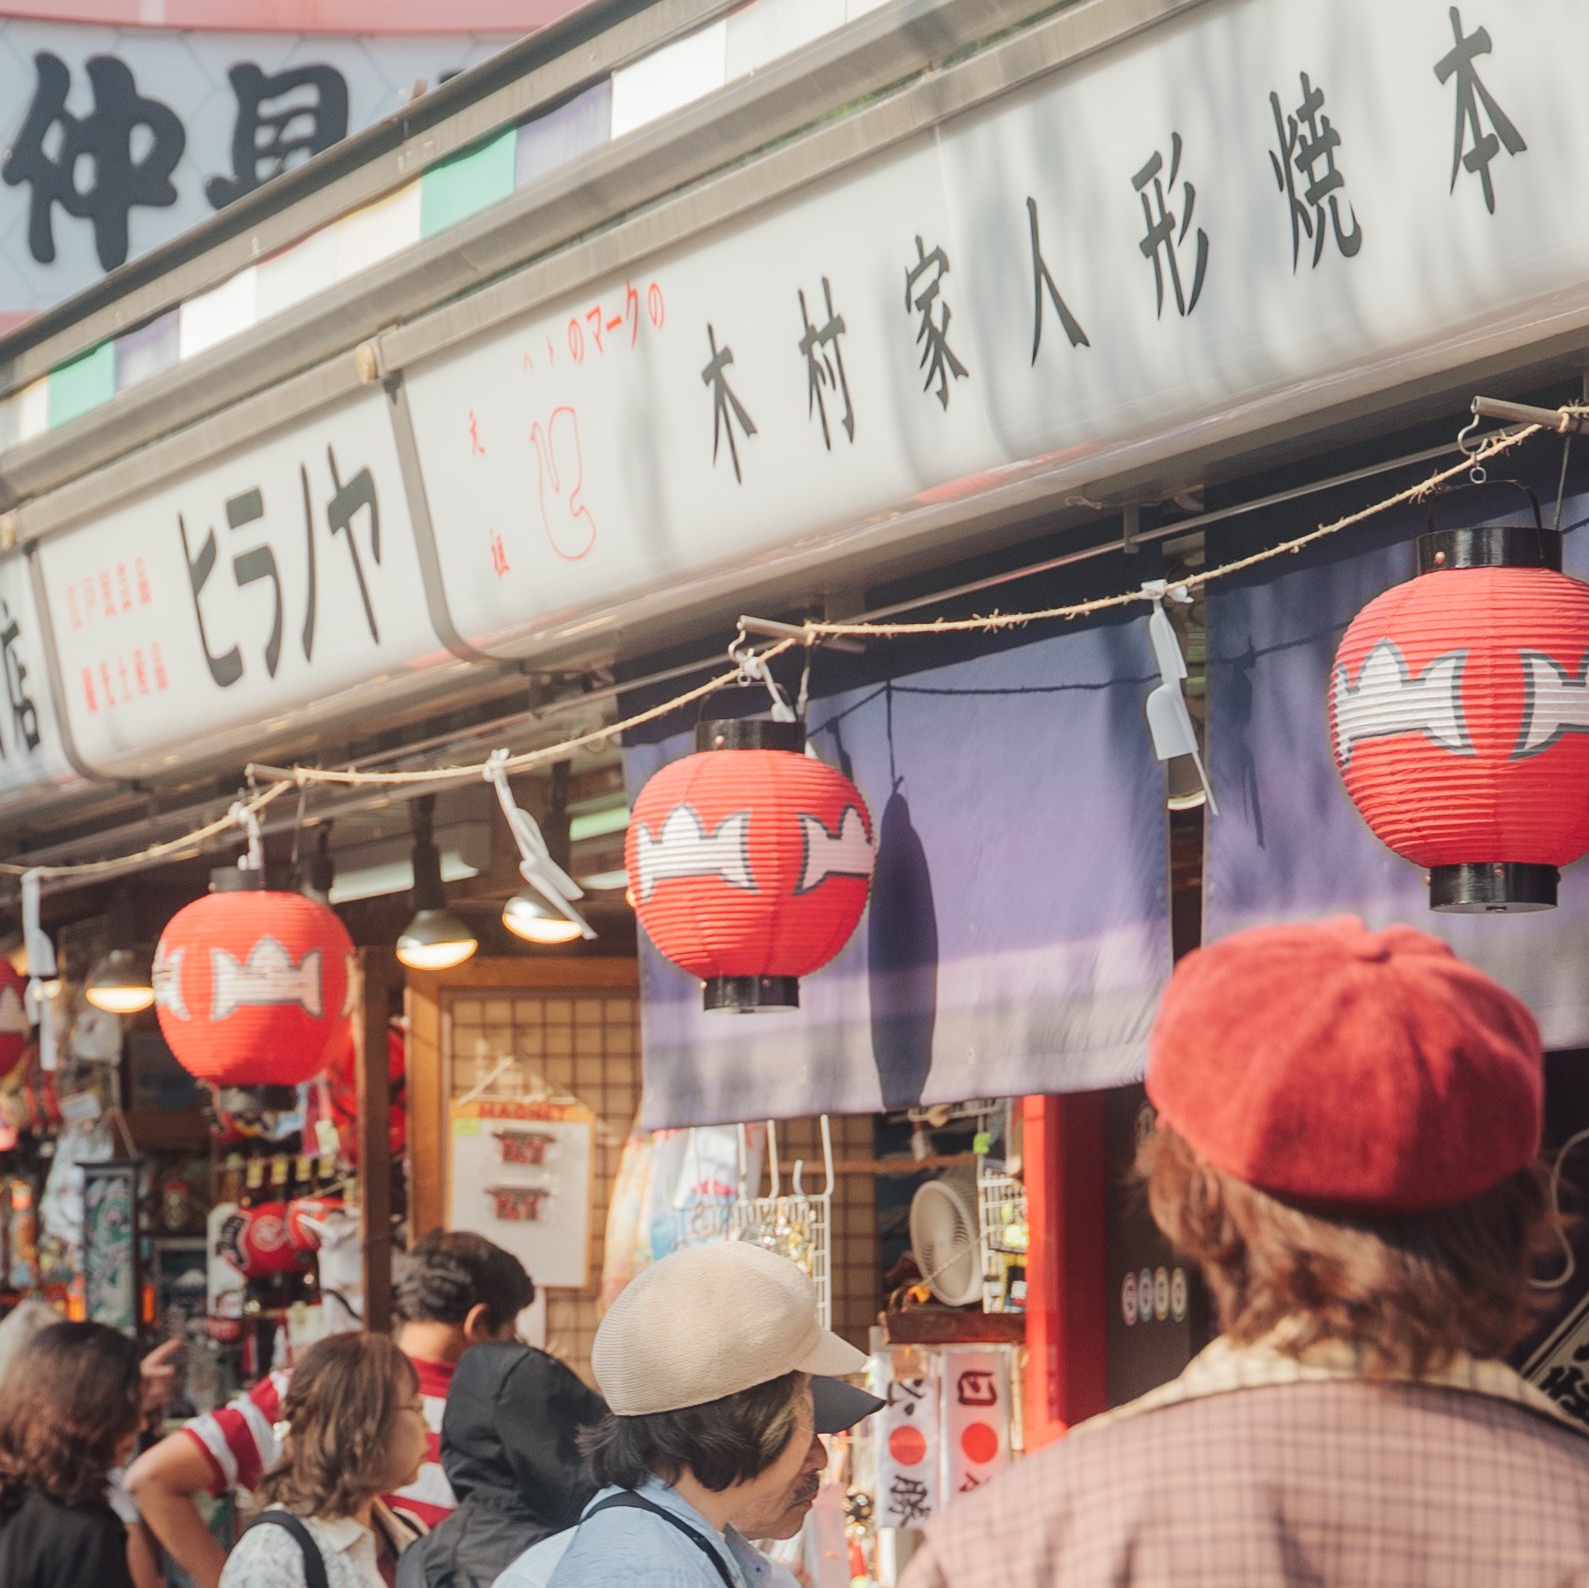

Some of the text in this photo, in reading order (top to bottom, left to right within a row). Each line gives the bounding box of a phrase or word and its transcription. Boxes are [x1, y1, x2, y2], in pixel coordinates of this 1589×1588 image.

[1, 50, 469, 274] 仲見
[177, 441, 381, 688] ヒラノヤ
